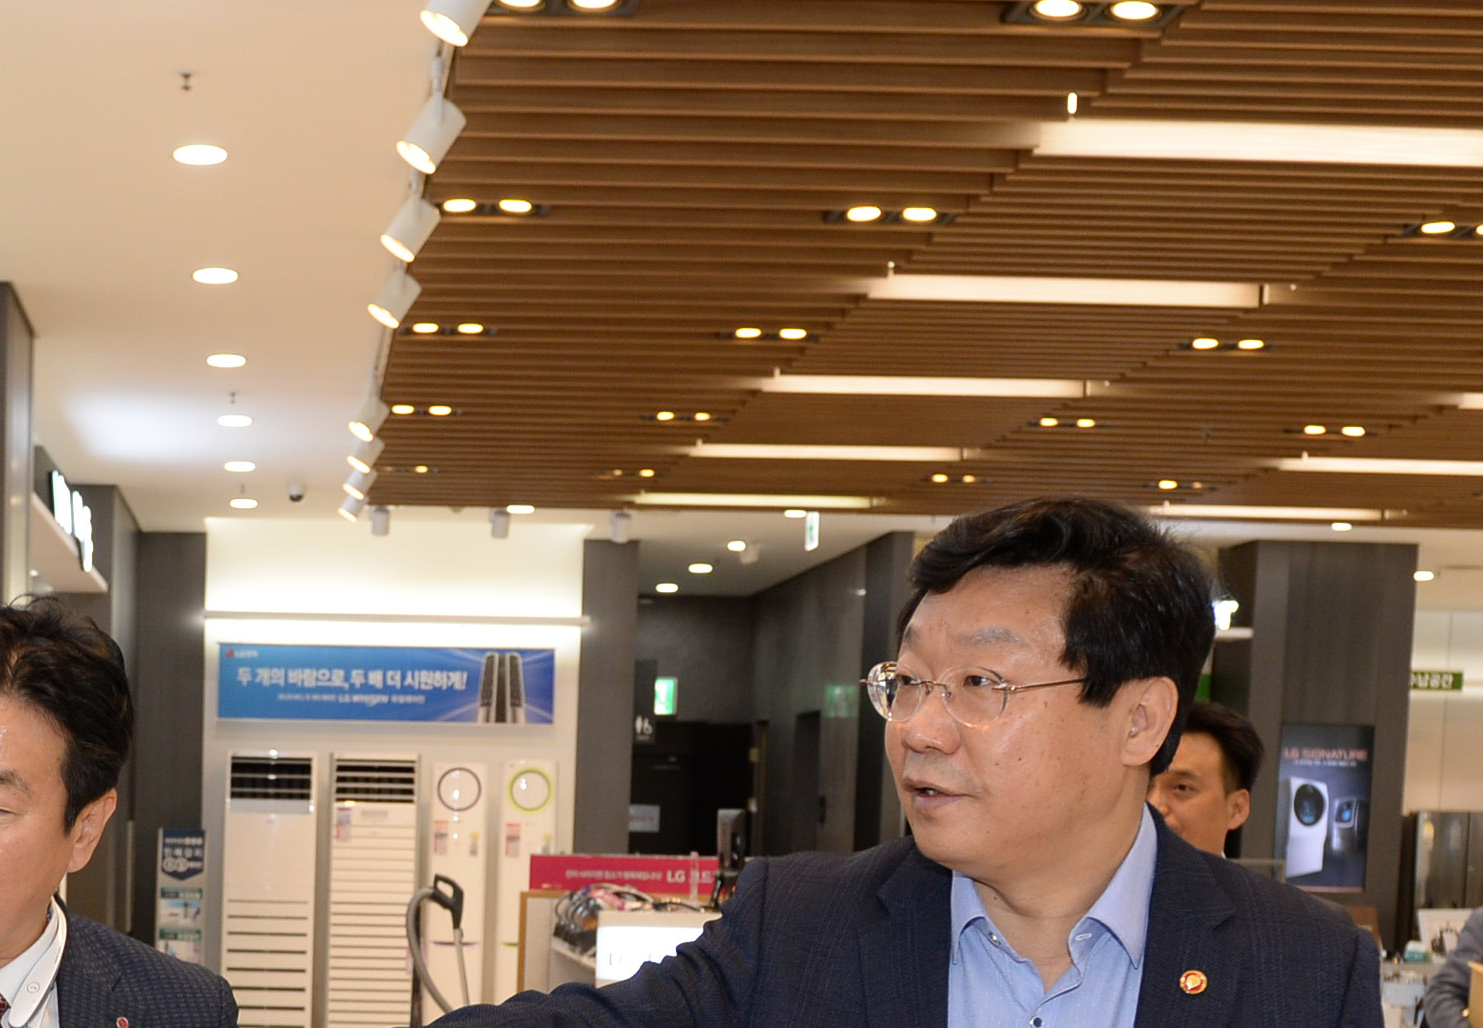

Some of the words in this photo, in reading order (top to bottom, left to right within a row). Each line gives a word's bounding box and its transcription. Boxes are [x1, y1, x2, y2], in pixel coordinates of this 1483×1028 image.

[237, 667, 252, 687] 두
[255, 667, 285, 687] 개의
[287, 668, 349, 690] 바람으로,
[350, 669, 366, 688] 두
[368, 669, 384, 690] 배
[386, 669, 402, 690] 더
[404, 669, 468, 691] 시원하게!
[1284, 746, 1300, 760] LG
[1303, 747, 1368, 762] SIGNATURE
[667, 869, 686, 884] LG
